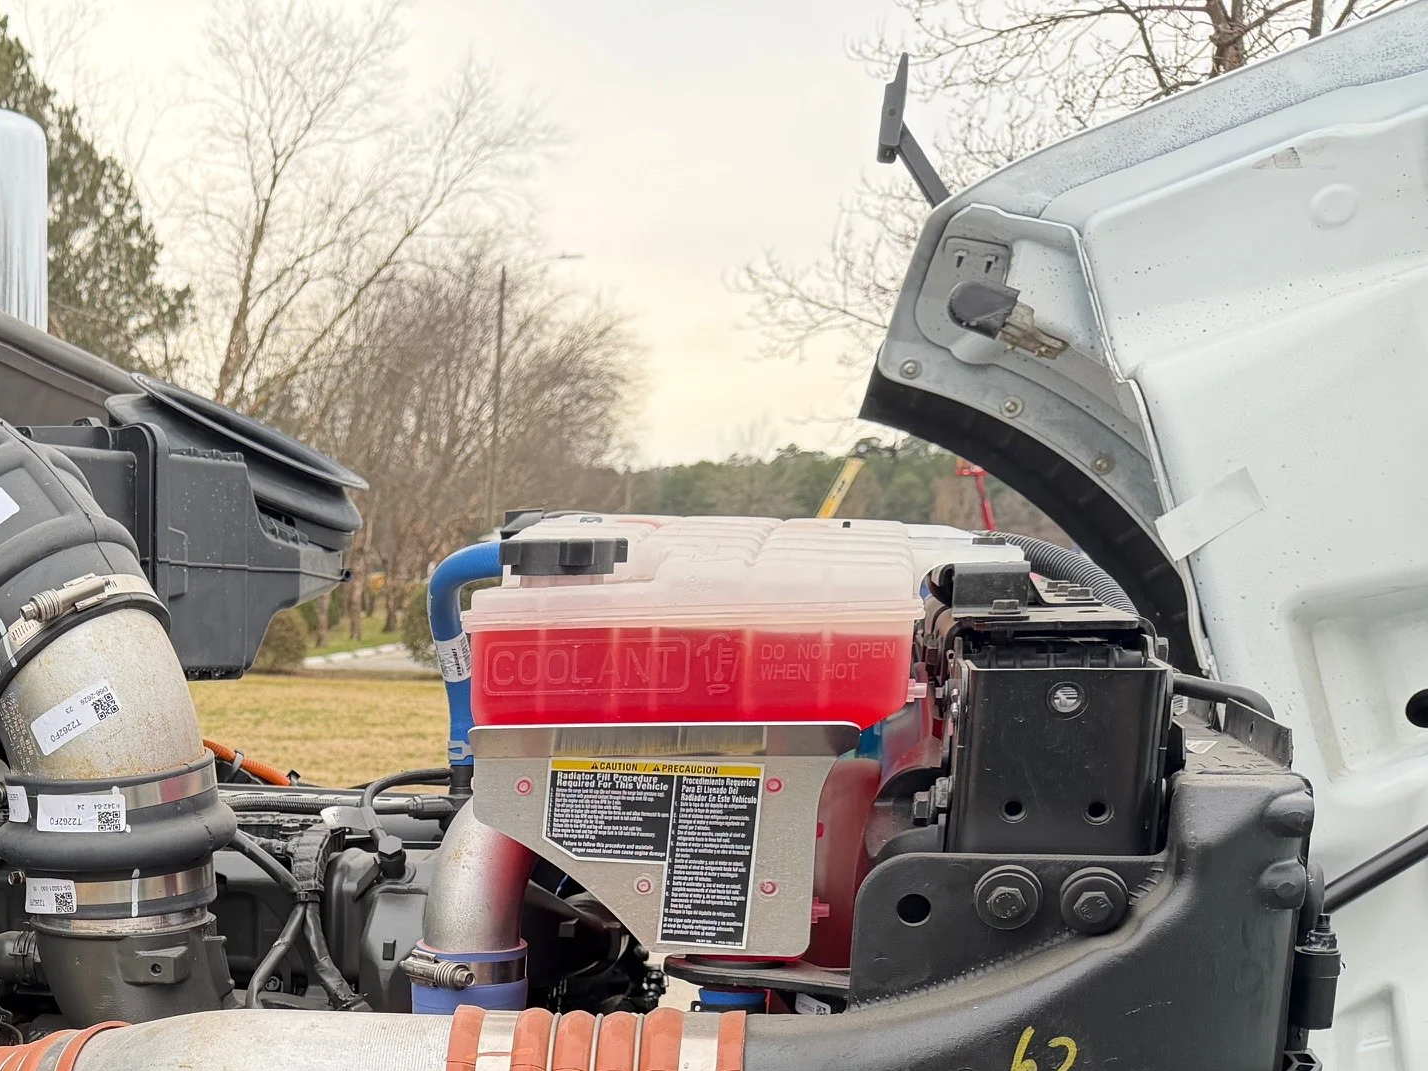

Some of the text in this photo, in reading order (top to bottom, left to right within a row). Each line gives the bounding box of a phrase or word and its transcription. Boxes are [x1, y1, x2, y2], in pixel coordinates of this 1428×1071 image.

[760, 642, 896, 660] DO NOT OPEN
[492, 646, 678, 685] COOLANT
[760, 663, 860, 680] WHEN HOT
[600, 762, 638, 771] CAUTION
[662, 765, 718, 774] PRECAUCION
[557, 771, 658, 784] Radiator Fill Procedure
[682, 775, 756, 789] Procedimiento Requerido
[556, 778, 669, 791] Required For This Vehicle
[681, 784, 739, 795] Para El Llenado Del
[680, 793, 708, 803] Radiador
[708, 794, 717, 802] En
[717, 794, 730, 803] Este
[50, 817, 82, 825] T2262F0
